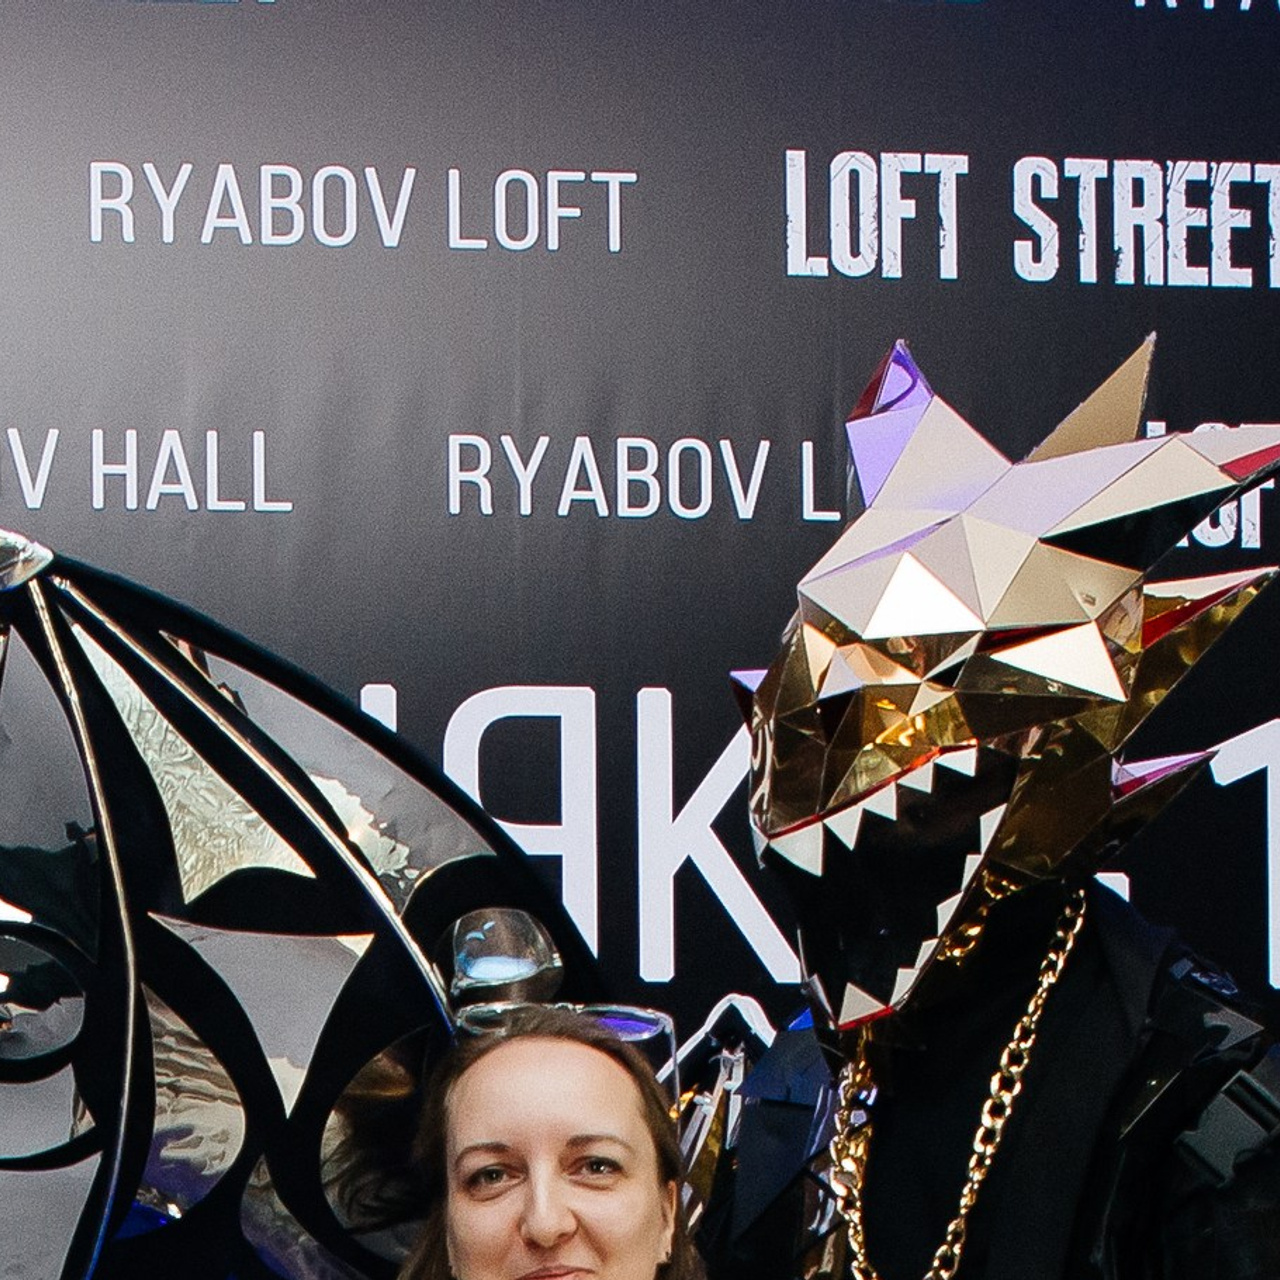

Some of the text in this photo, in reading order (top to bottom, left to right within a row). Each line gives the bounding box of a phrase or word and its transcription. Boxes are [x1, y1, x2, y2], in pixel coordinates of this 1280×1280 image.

[90, 161, 638, 252] RYABOV LOFT
[785, 149, 1280, 288] LOFT STREET
[92, 428, 293, 511] HALL
[448, 434, 770, 519] RYABOV
